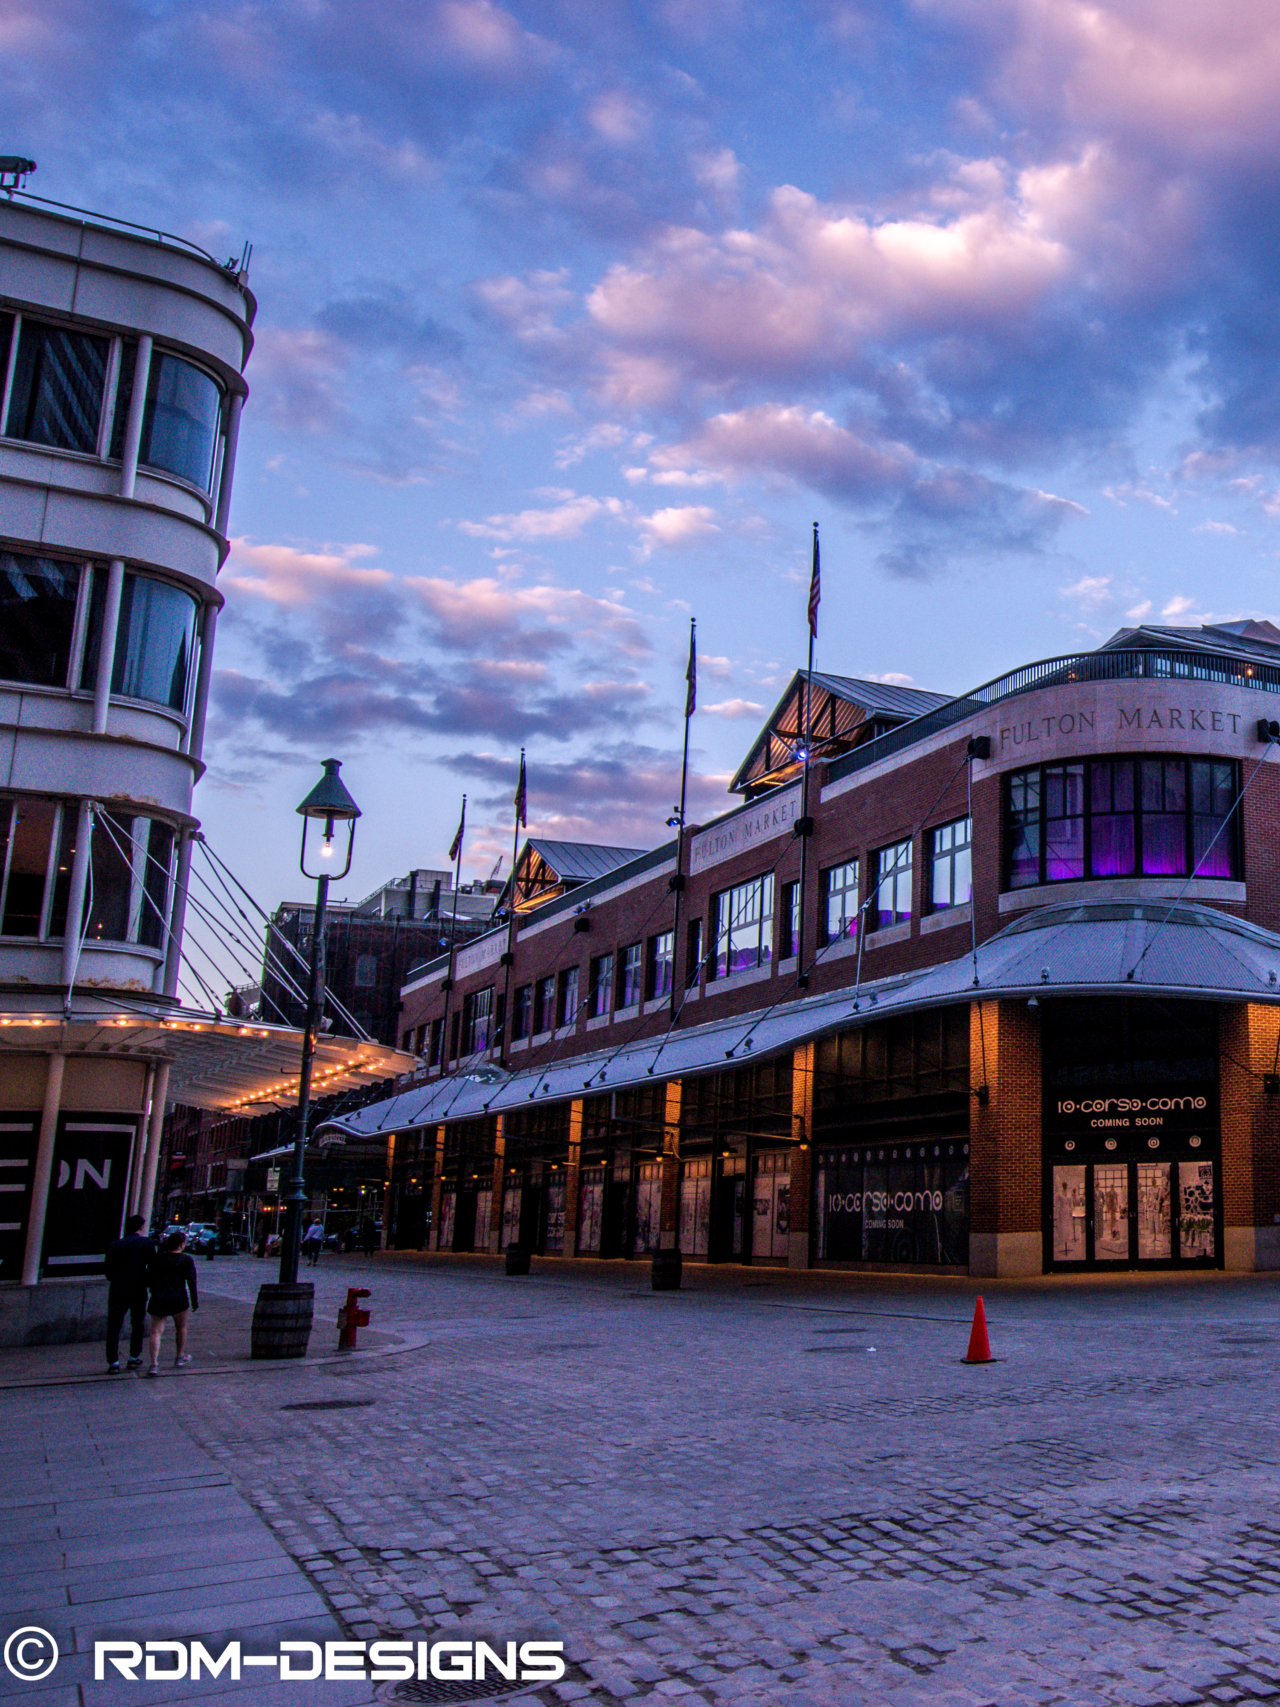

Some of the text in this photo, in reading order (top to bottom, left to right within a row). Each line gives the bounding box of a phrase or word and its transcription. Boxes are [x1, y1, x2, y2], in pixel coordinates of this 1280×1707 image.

[1000, 707, 1241, 750] FULTON MARKET
[693, 800, 797, 863] FULTON MARKET
[1090, 1117, 1163, 1128] COMING SOON
[864, 1219, 905, 1229] COMING SOON
